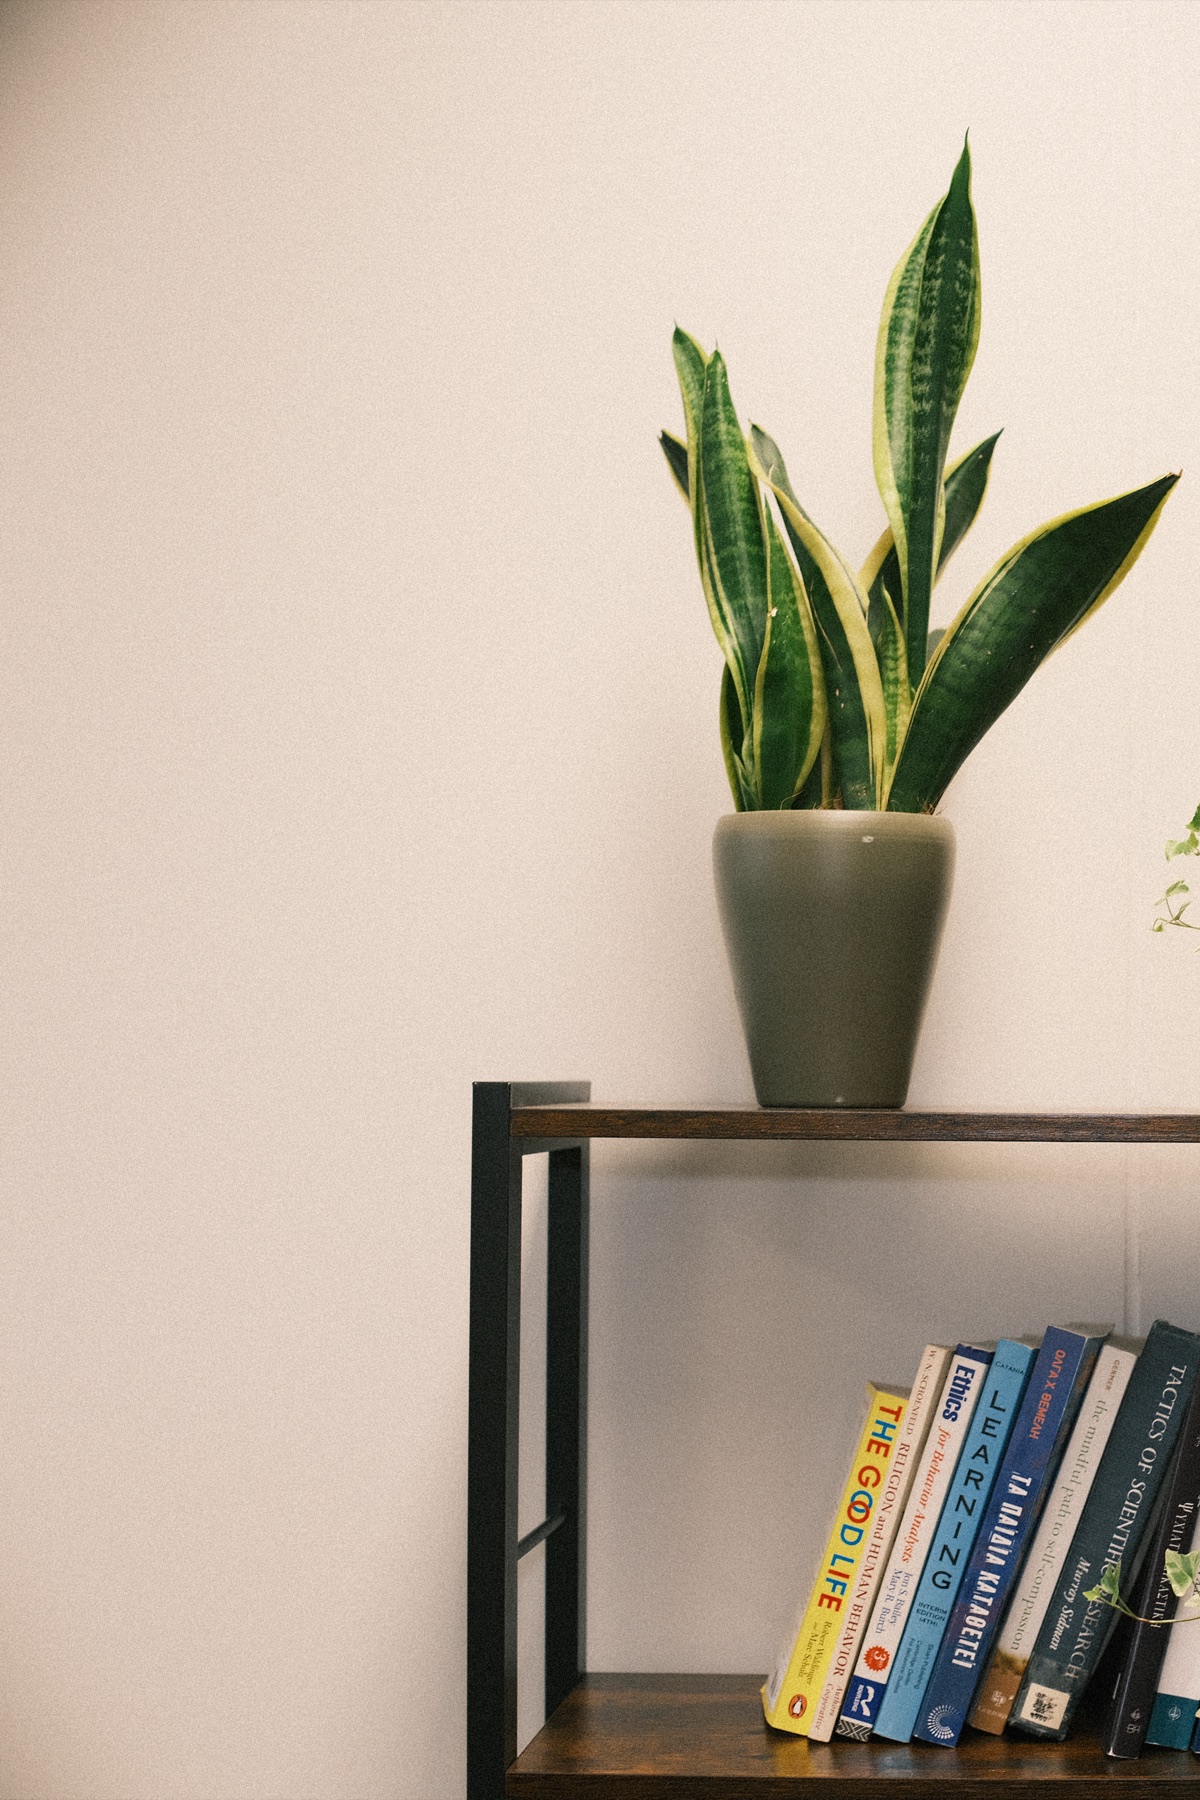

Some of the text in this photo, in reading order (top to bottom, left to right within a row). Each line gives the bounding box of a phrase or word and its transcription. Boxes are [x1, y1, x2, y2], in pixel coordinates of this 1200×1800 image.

[996, 1361, 1025, 1375] CATANIA
[1048, 1349, 1066, 1379] ΟΛΓΑ
[1106, 1360, 1120, 1391] GERMER
[906, 1375, 929, 1434] SCHOENFELD
[1029, 1393, 1053, 1440] ΘΕΜΕΛΗ
[1148, 1365, 1187, 1442] TACTICS
[902, 1364, 976, 1564] Ethics for Behavior Analysts
[1137, 1447, 1157, 1475] OF
[932, 1390, 1006, 1589] LEARNING
[1008, 1473, 1032, 1496] ΤΑ
[817, 1406, 903, 1612] THE GOOD LIFE
[1011, 1400, 1108, 1651] the mindful path to self-compassion
[833, 1442, 911, 1676] RELIGION and HUMAN BEHAVIOR
[886, 1569, 902, 1591] Mary
[902, 1571, 913, 1588] Jon
[884, 1592, 893, 1603] R.
[891, 1599, 906, 1626] Bailey
[919, 1602, 947, 1615] INTERIM
[1049, 1556, 1091, 1650] Murray Sidman
[875, 1607, 889, 1634] Burch
[916, 1609, 945, 1621] EDITION
[820, 1621, 832, 1645] Robert
[1064, 1586, 1108, 1680] ESEARCH
[829, 1684, 843, 1716] Authors
